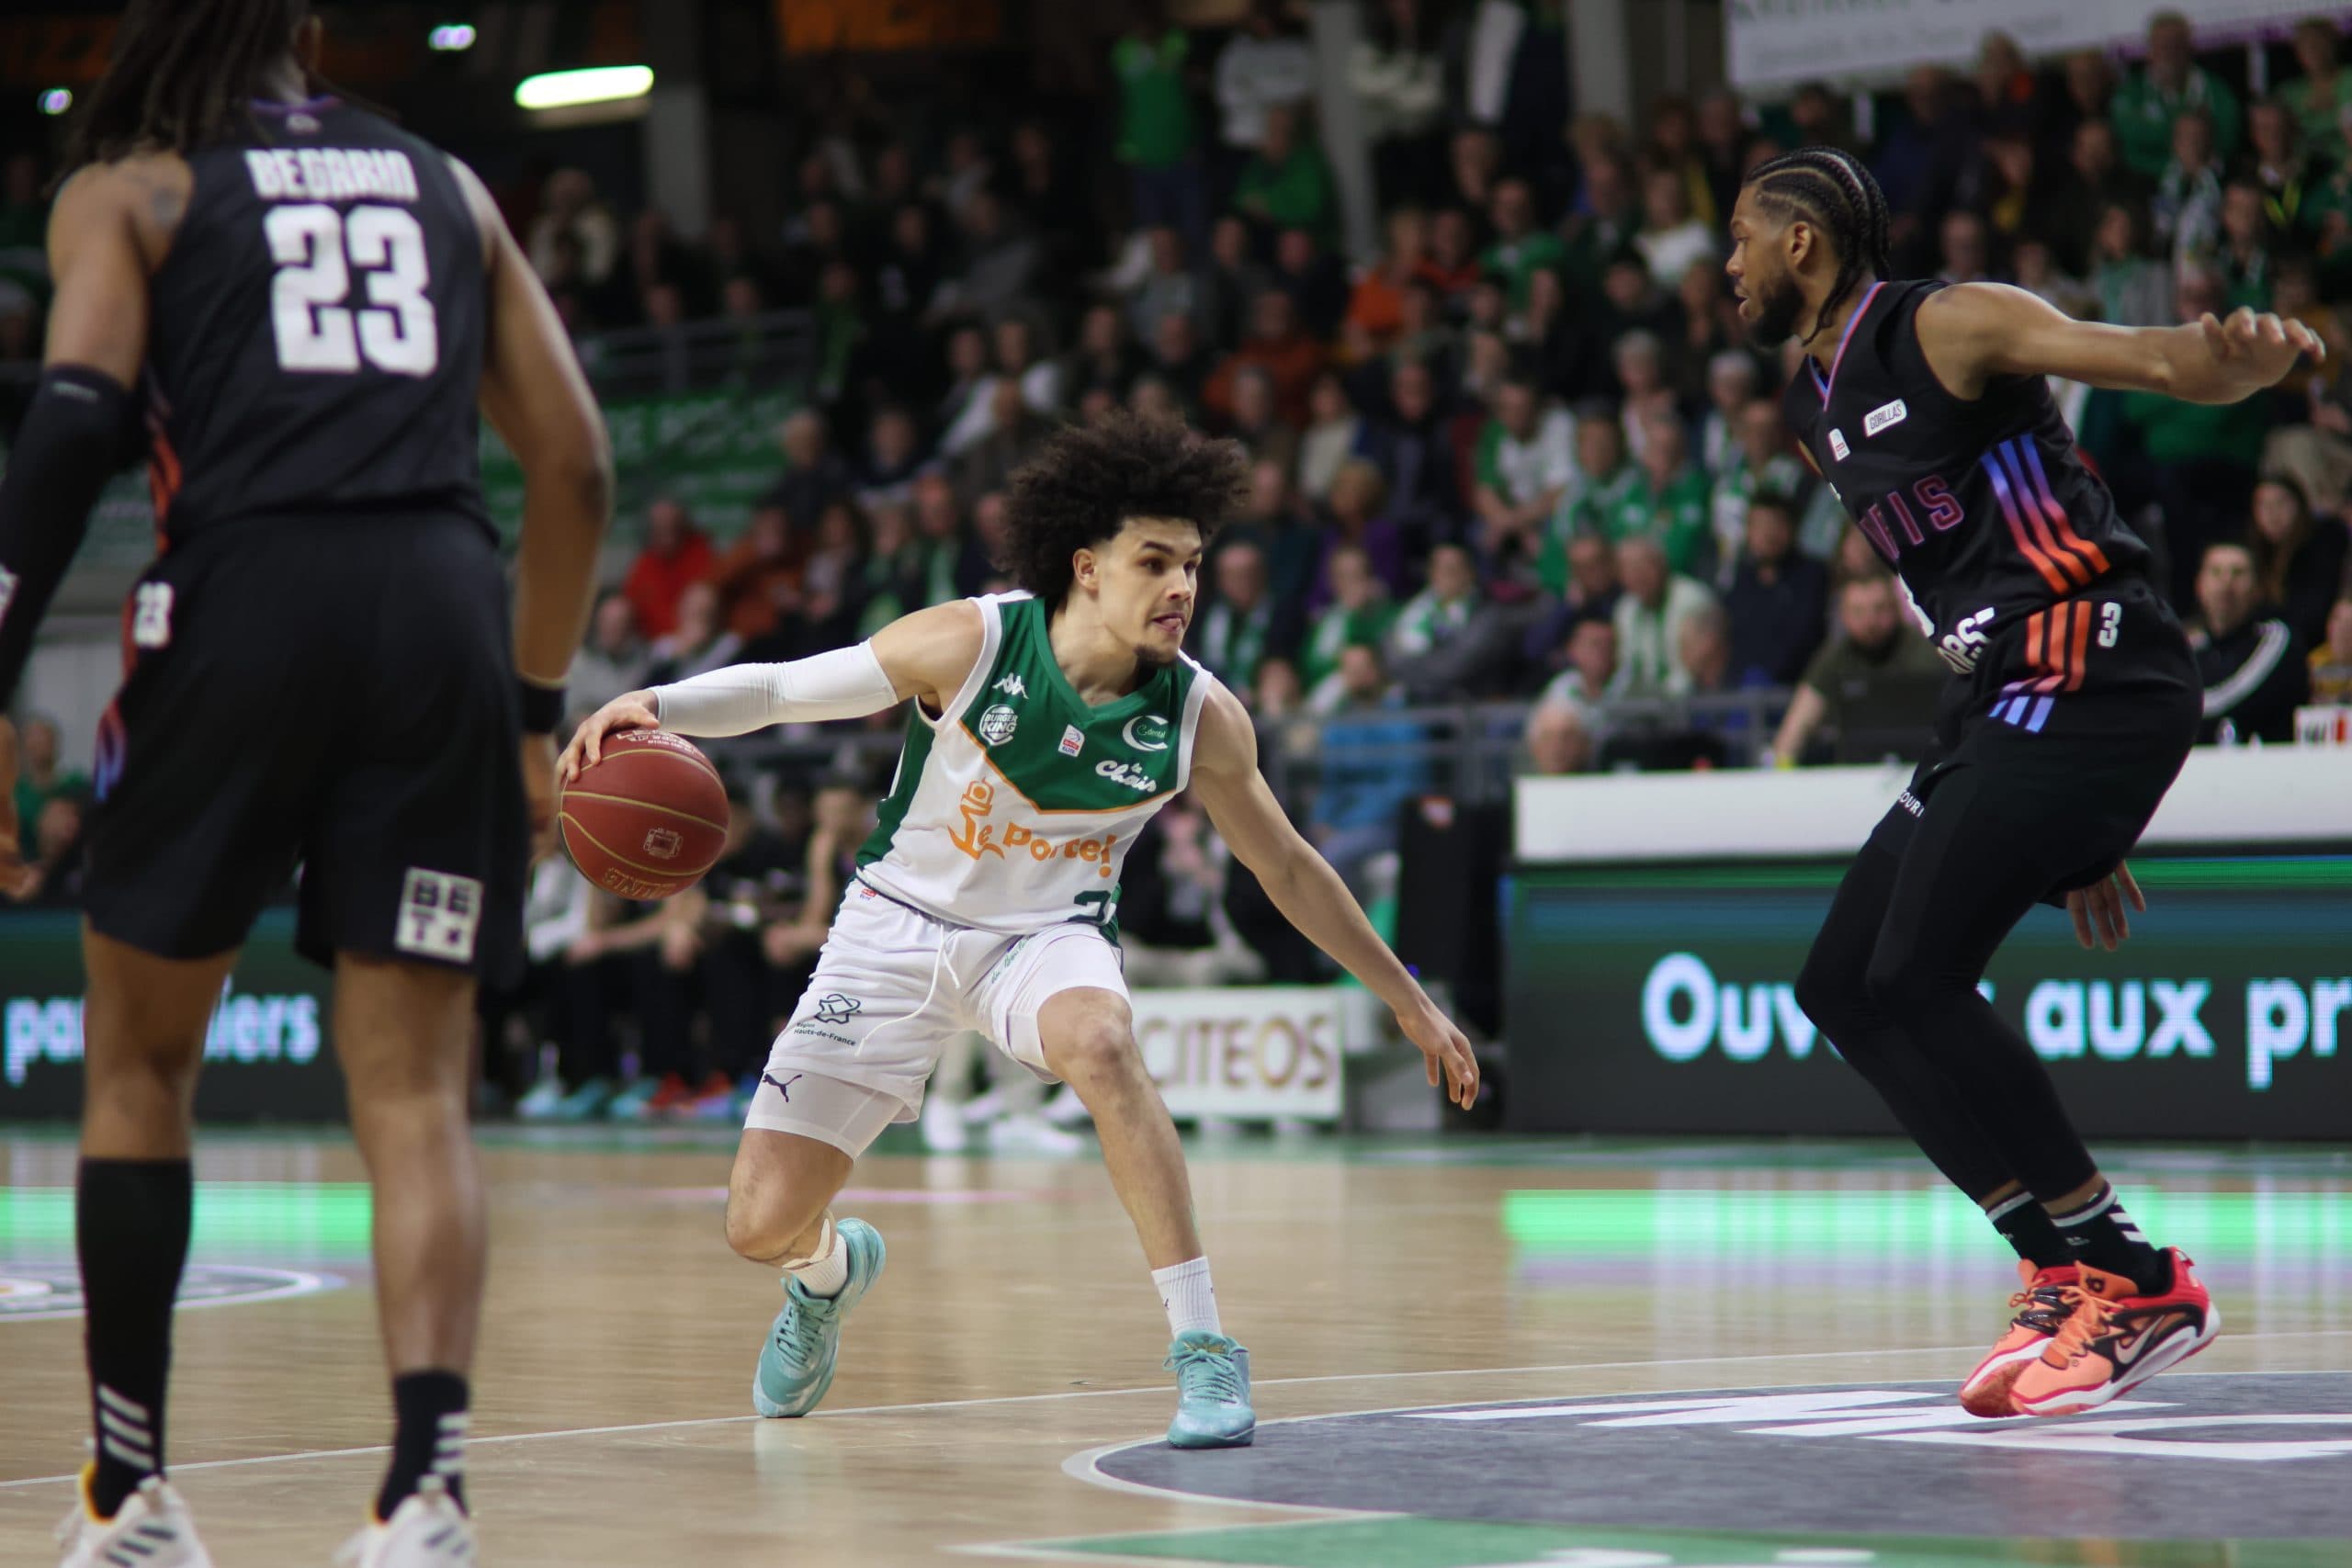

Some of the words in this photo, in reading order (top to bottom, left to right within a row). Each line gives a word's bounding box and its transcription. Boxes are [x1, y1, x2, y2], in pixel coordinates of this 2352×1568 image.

[264, 204, 438, 378] 23
[1869, 403, 1903, 430] GORILLAS
[2097, 602, 2121, 649] 3
[983, 721, 1017, 733] KING
[984, 713, 1018, 724] BURGER
[794, 1028, 856, 1046] Hauts-de-France
[1138, 1014, 1331, 1089] CITEOS
[2024, 978, 2216, 1059] aux
[2246, 977, 2352, 1090] pr
